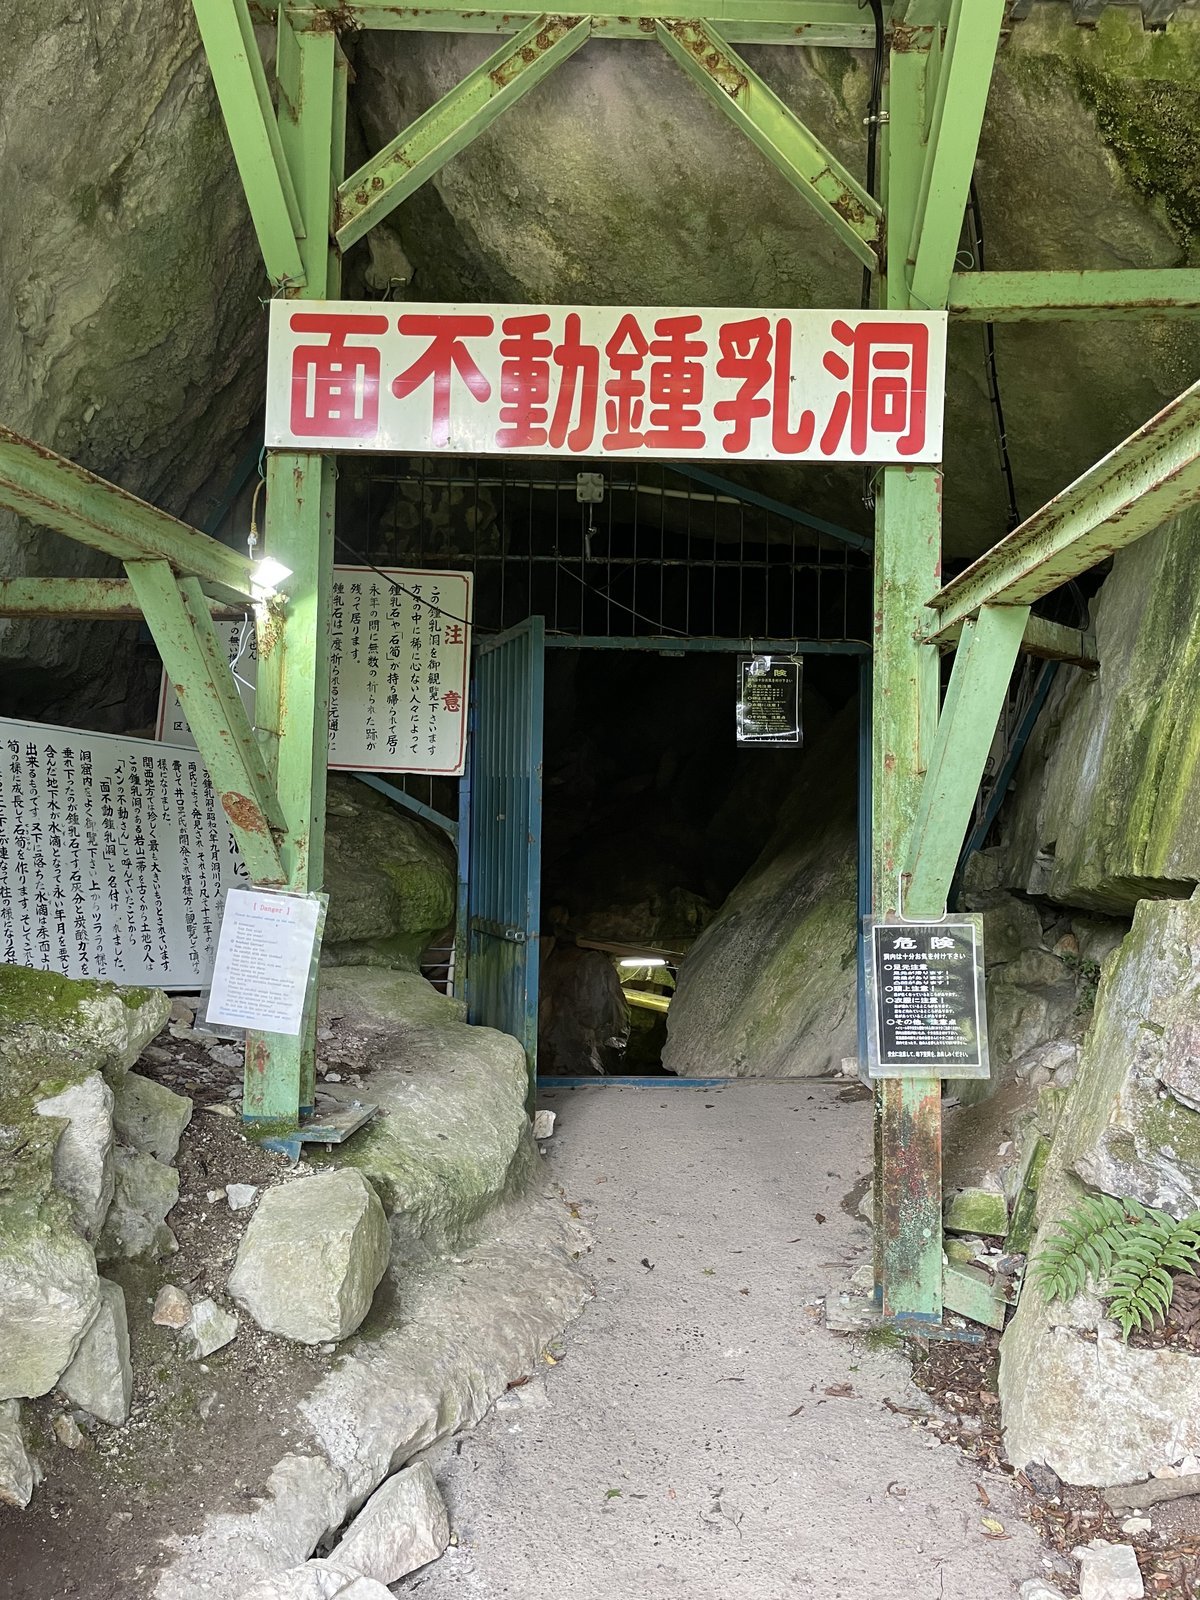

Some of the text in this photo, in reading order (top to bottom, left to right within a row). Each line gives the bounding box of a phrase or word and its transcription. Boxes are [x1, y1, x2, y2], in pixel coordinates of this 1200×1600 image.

[290, 313, 929, 455] 面不動鍾乳洞
[260, 904, 282, 914] Danger
[893, 936, 955, 949] 危険
